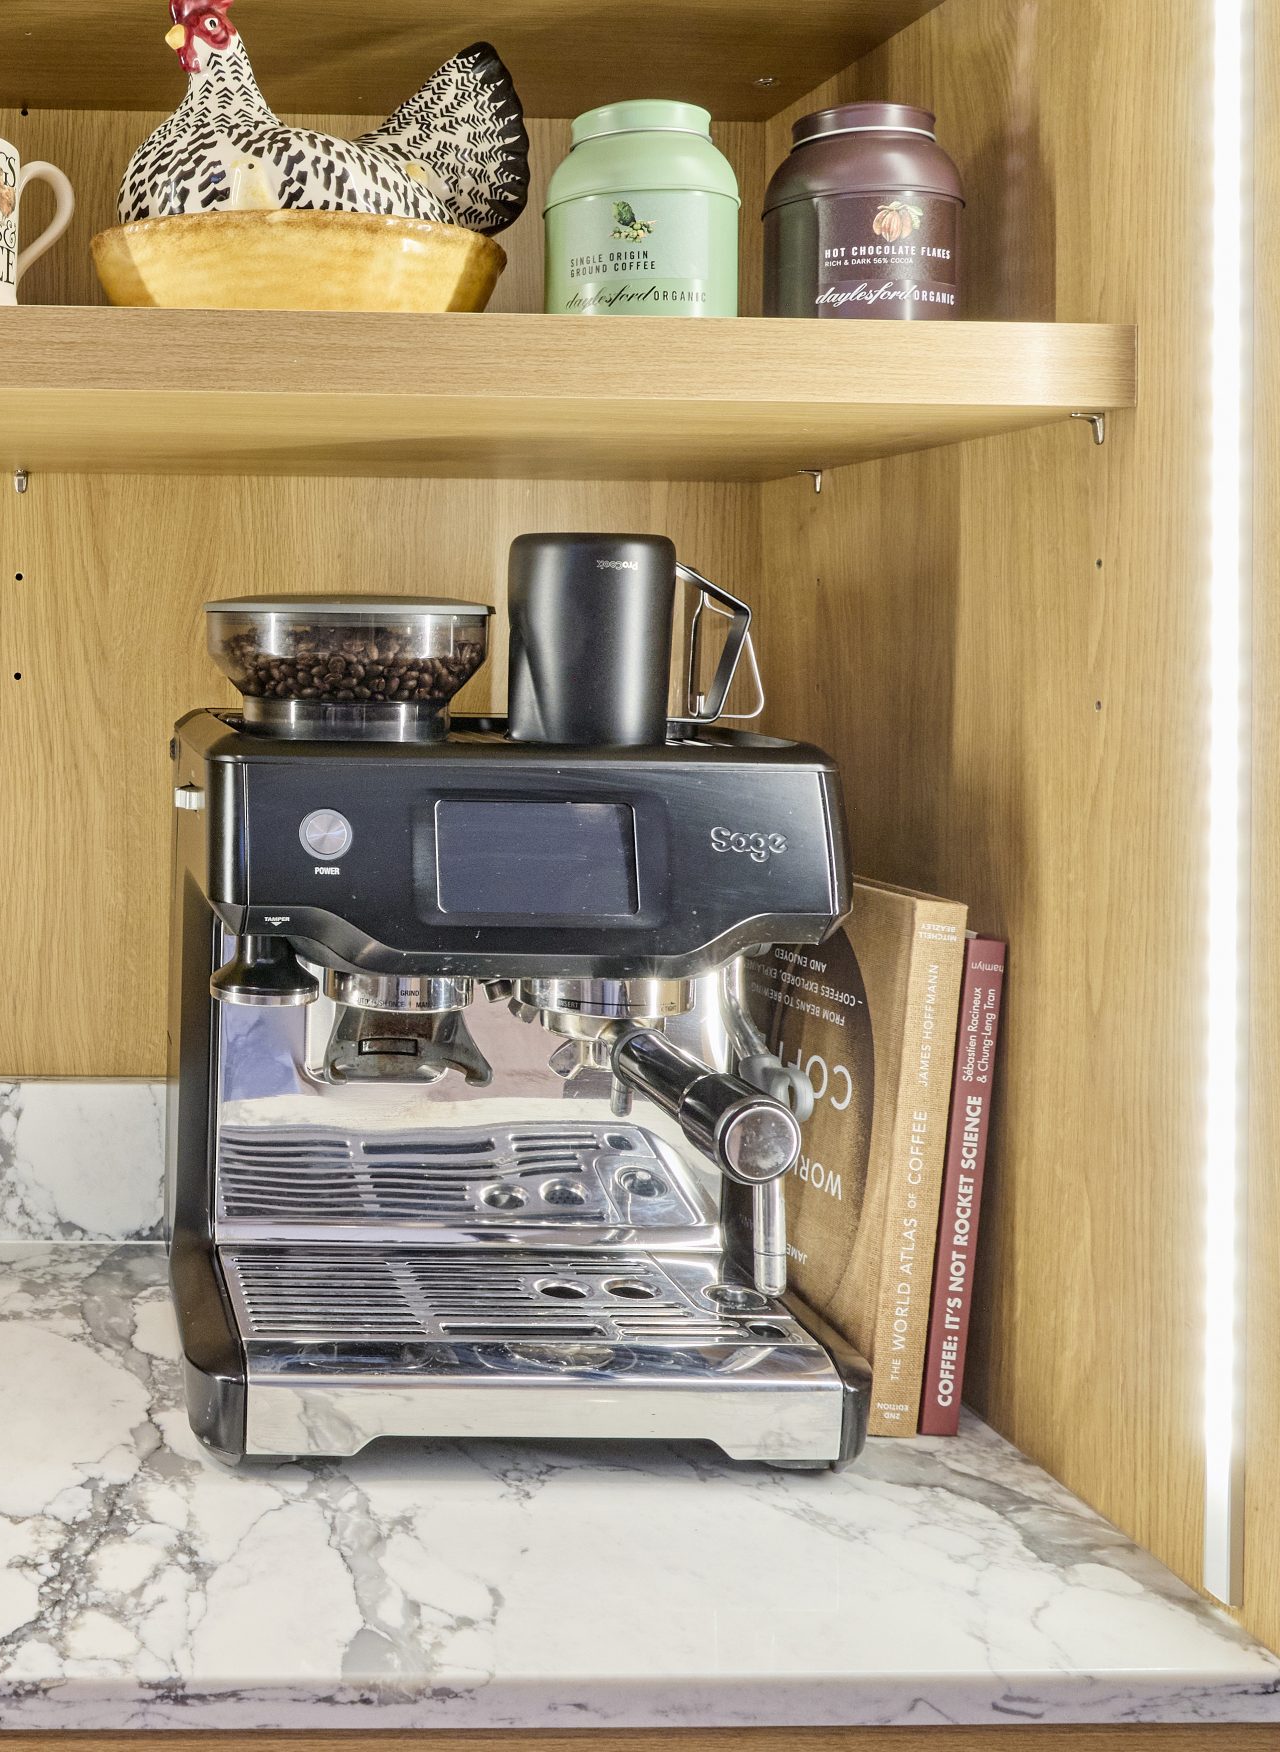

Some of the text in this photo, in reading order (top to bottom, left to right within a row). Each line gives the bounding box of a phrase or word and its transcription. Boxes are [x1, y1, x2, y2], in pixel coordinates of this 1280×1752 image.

[571, 250, 649, 268] SINGLE ORIGIN
[824, 246, 951, 260] HOT CHOCOLATE FLAKES
[843, 258, 849, 266] &
[570, 261, 656, 278] GROUND COFFEE
[566, 284, 707, 310] daylesford ORGANIC
[815, 282, 955, 308] daylesford ORGANIC
[710, 826, 788, 862] Sage
[314, 866, 340, 875] POWER
[918, 931, 957, 942] MITCHELL
[774, 948, 827, 974] AND ENJOYED
[971, 961, 1004, 973] hamlyn
[780, 968, 818, 994] EXPLORED,
[400, 989, 420, 997] GRIND
[784, 994, 794, 1008] TO
[821, 988, 856, 1007] COFFEES
[797, 999, 820, 1017] BEANS
[822, 1011, 845, 1026] FROM
[918, 964, 940, 1087] JAMES HOFFMANN
[962, 987, 982, 1082] Sébastien Racineux
[976, 988, 996, 1084] & Chung-Leng Tran
[890, 1110, 928, 1381] THE WORLD ATLAS OF COFFEE
[937, 1095, 982, 1407] COFFEE: IT'S NOT ROCKET SCIENCE
[877, 1402, 909, 1411] EDITION
[883, 1412, 901, 1420] 2ND
